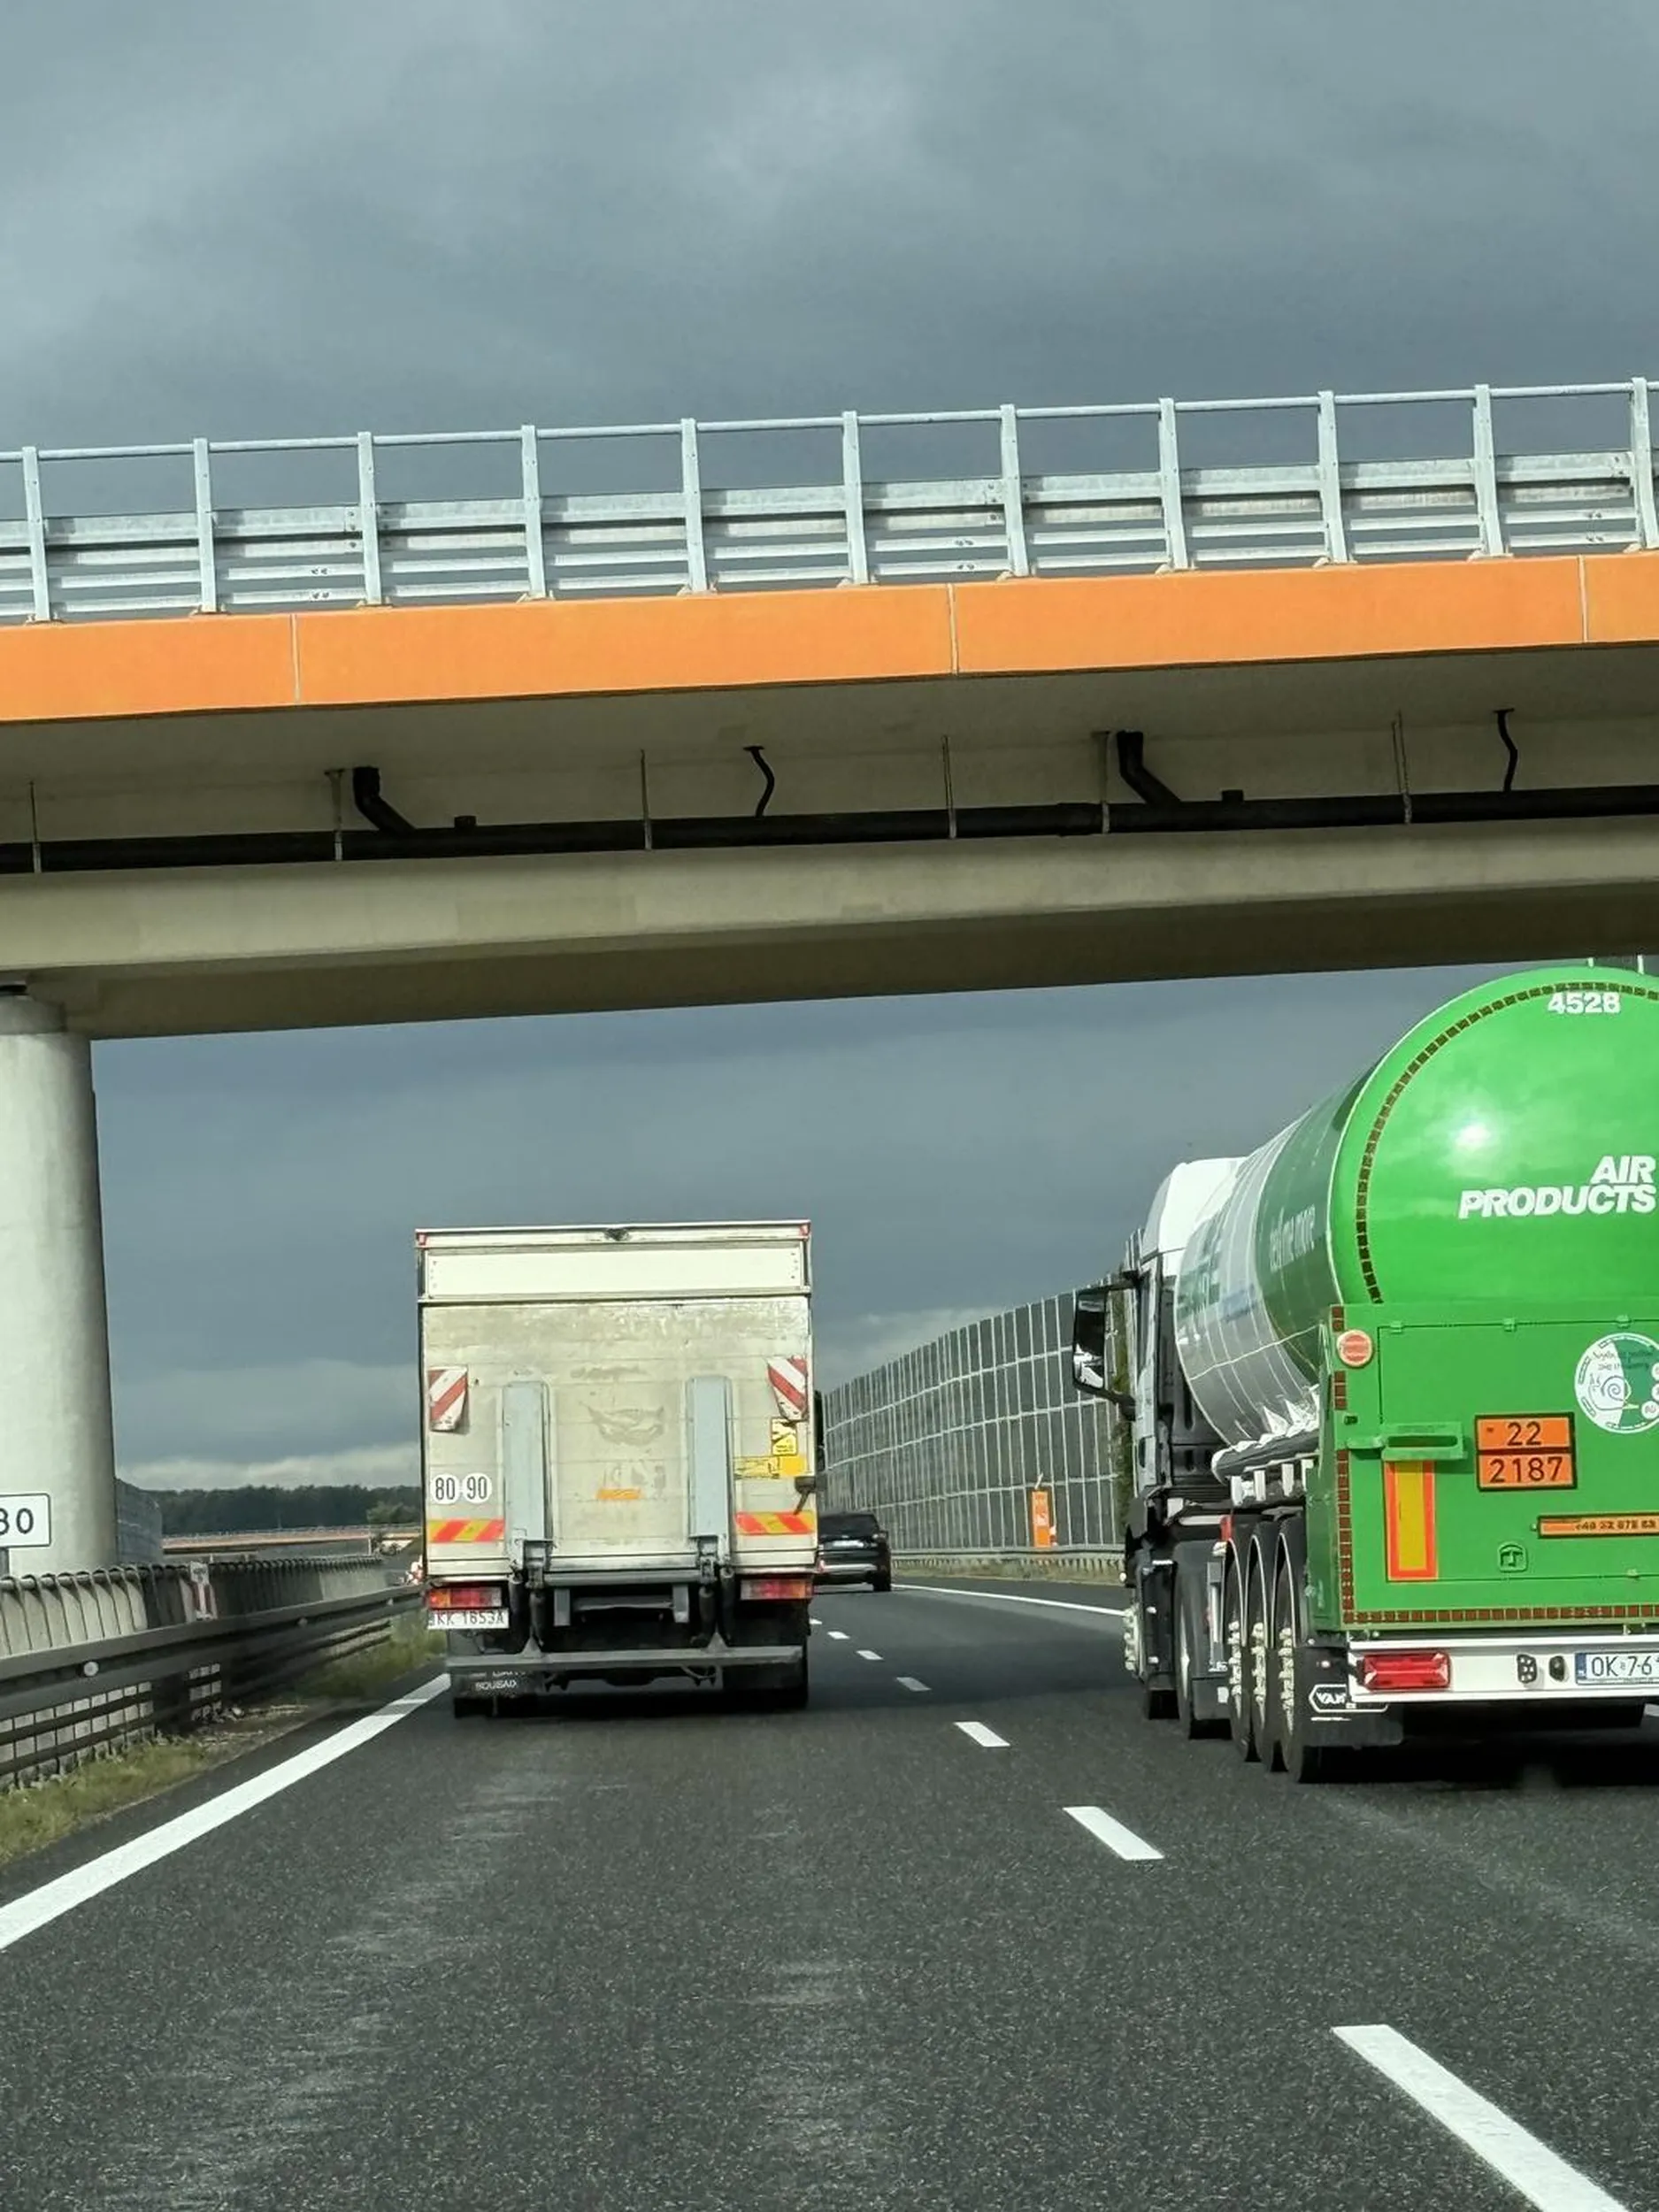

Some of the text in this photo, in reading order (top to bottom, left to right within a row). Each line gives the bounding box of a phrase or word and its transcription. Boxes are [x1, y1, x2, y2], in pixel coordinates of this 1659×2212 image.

[1548, 992, 1620, 1014] 4528
[1590, 1156, 1655, 1184] AIR
[1458, 1184, 1656, 1219] PRODUCTS
[1507, 1422, 1541, 1446] 22
[1489, 1456, 1563, 1483] 2187
[435, 1477, 455, 1500] 80
[466, 1476, 487, 1500] 90
[1592, 1655, 1659, 1676] OK 76
